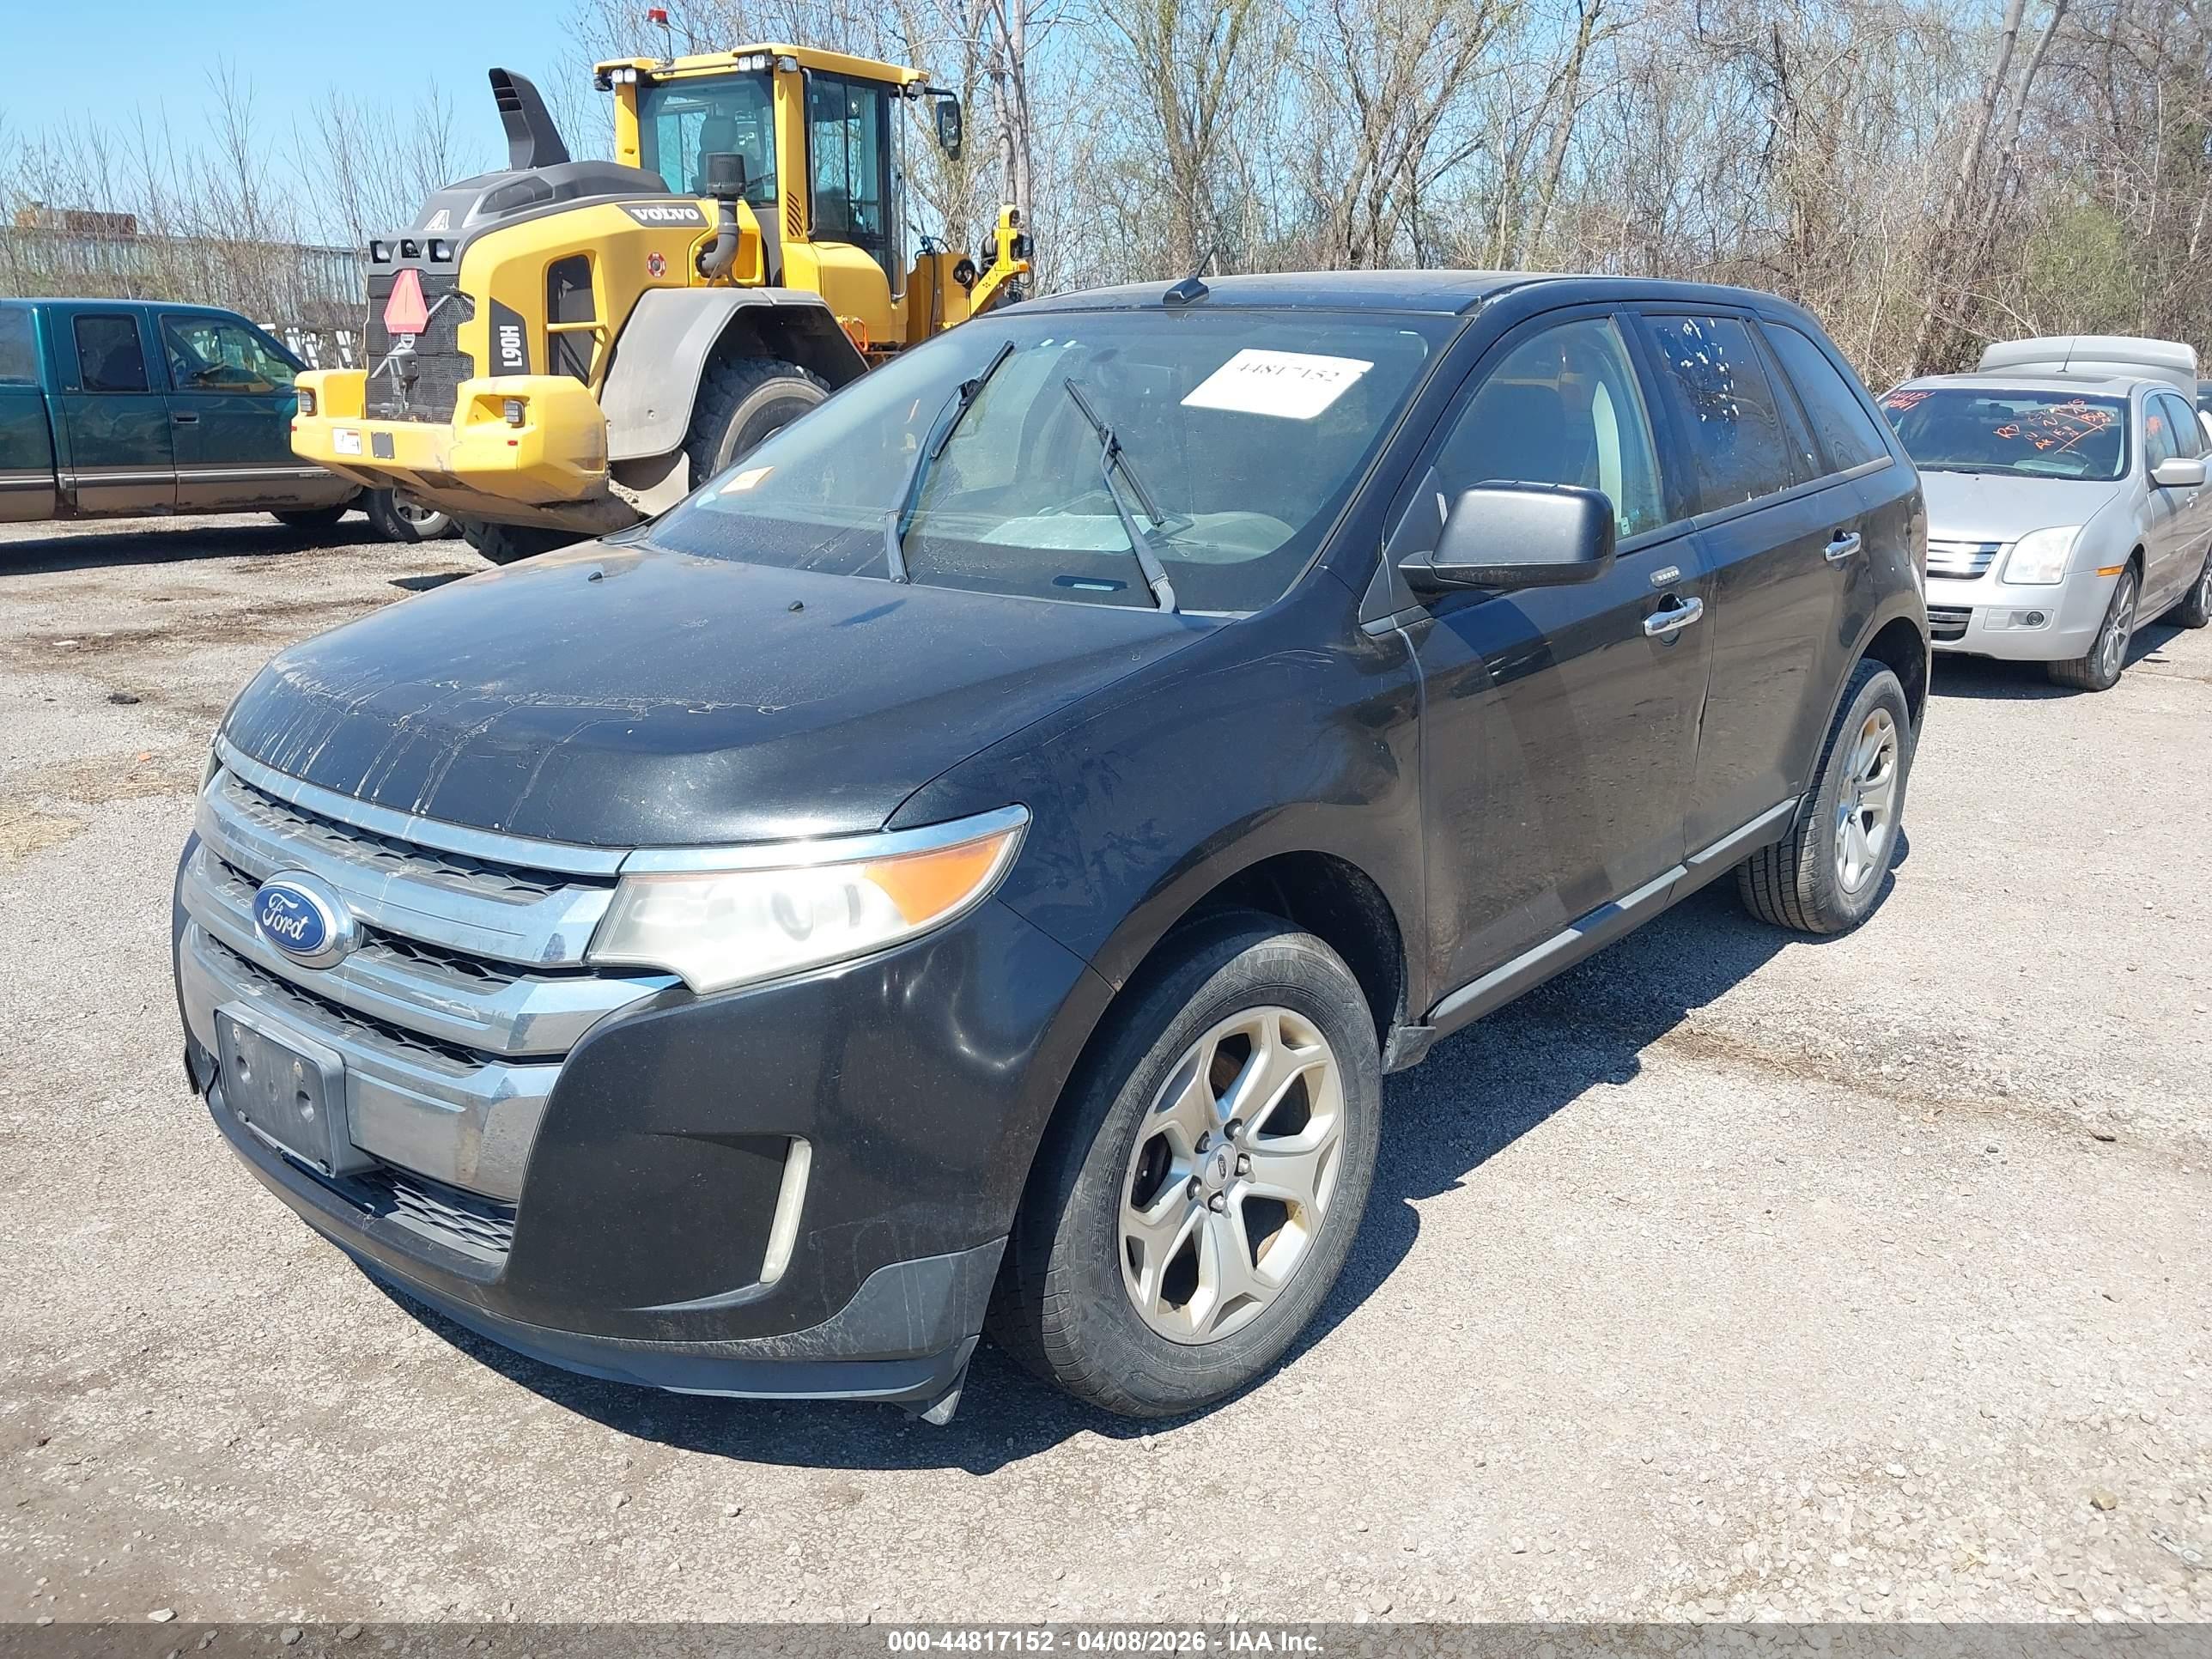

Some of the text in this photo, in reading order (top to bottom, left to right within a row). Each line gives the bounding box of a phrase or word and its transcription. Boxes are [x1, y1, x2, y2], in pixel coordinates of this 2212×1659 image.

[630, 208, 700, 221] VOLVO
[499, 325, 523, 367] L90H
[262, 892, 309, 940] Ford
